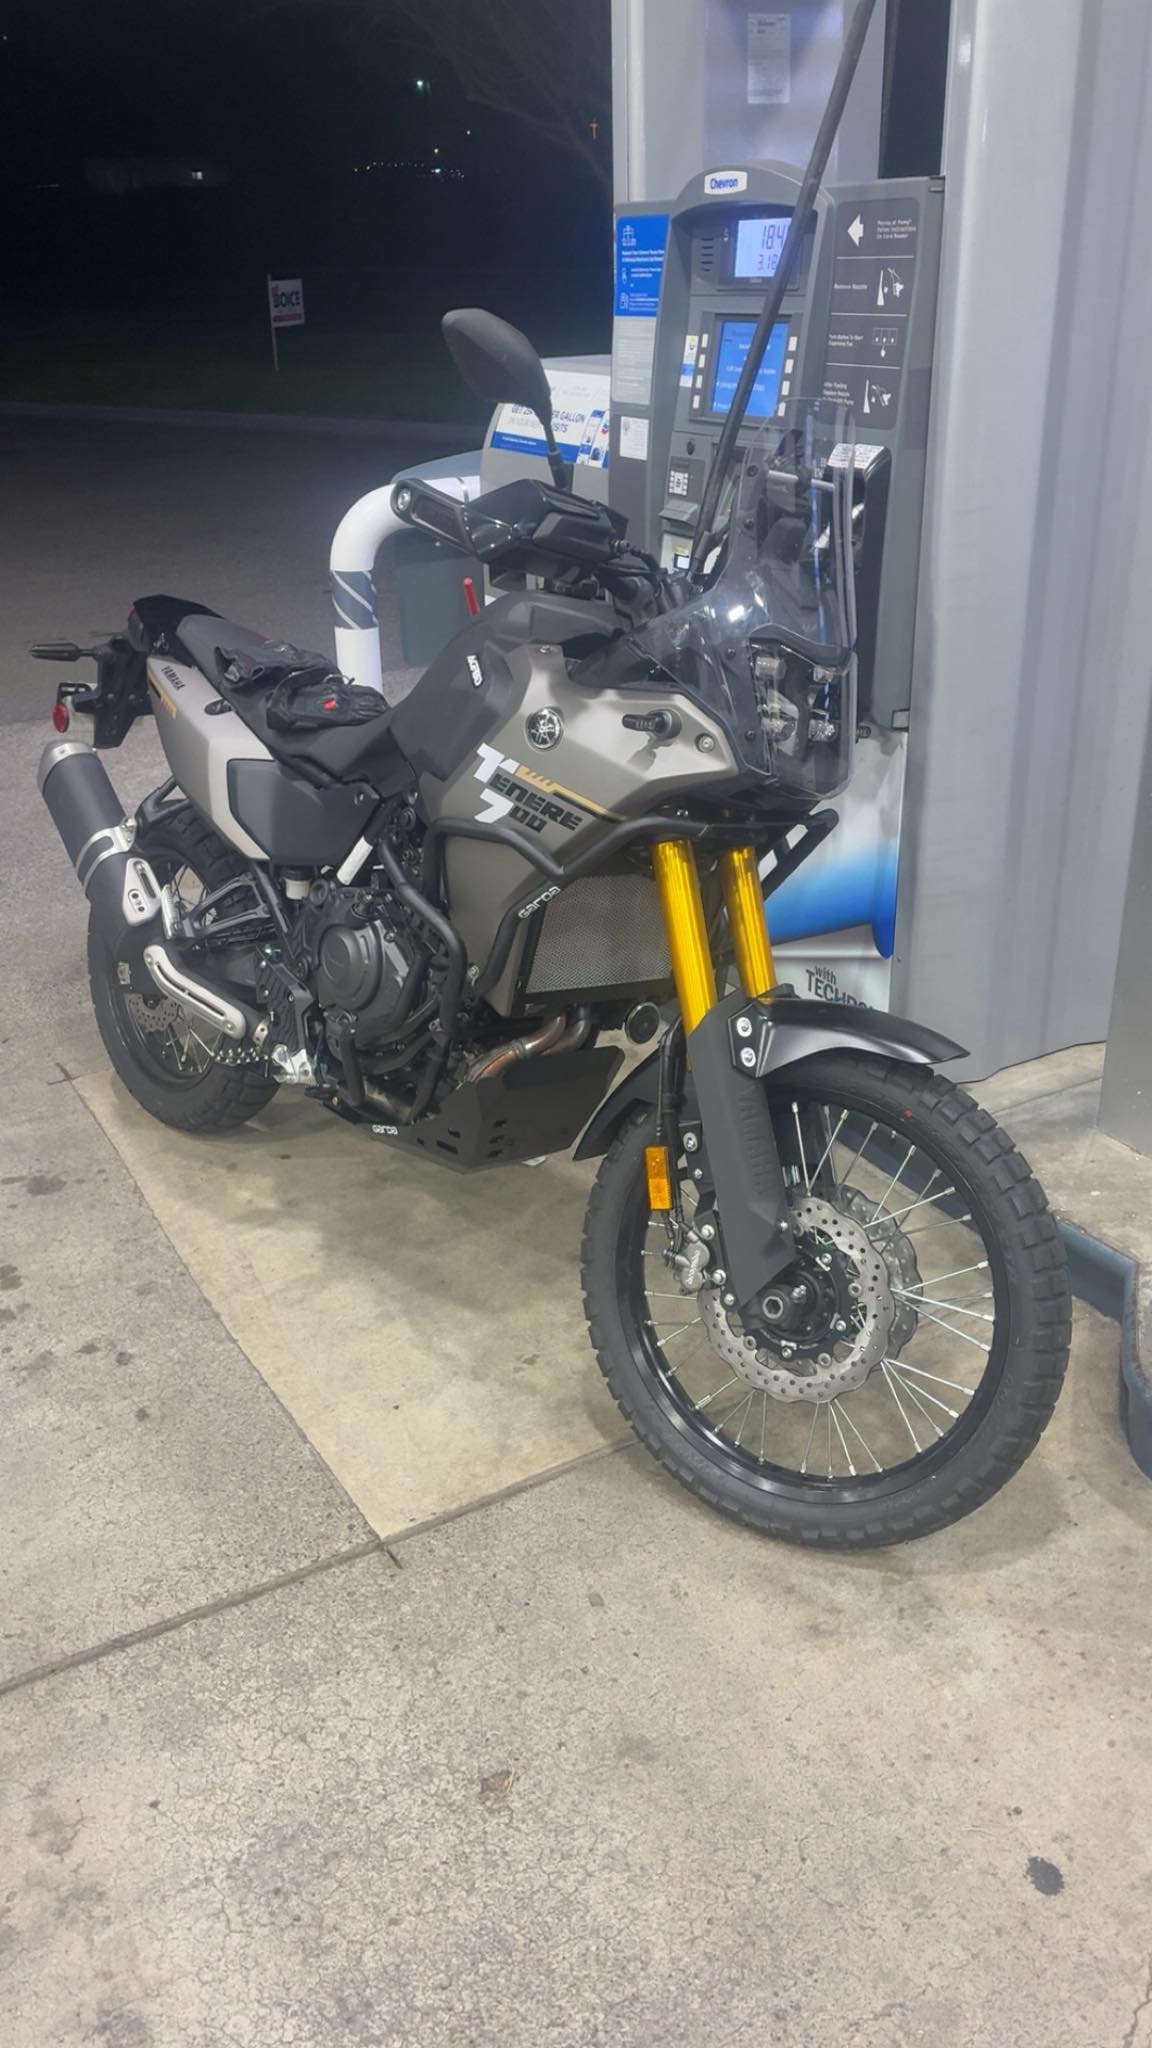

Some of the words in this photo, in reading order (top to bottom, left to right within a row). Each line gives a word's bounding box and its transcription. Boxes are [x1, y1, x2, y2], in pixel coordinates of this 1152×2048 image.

[710, 178, 738, 189] Chevron
[560, 411, 585, 423] GALLON
[474, 788, 548, 834] 700
